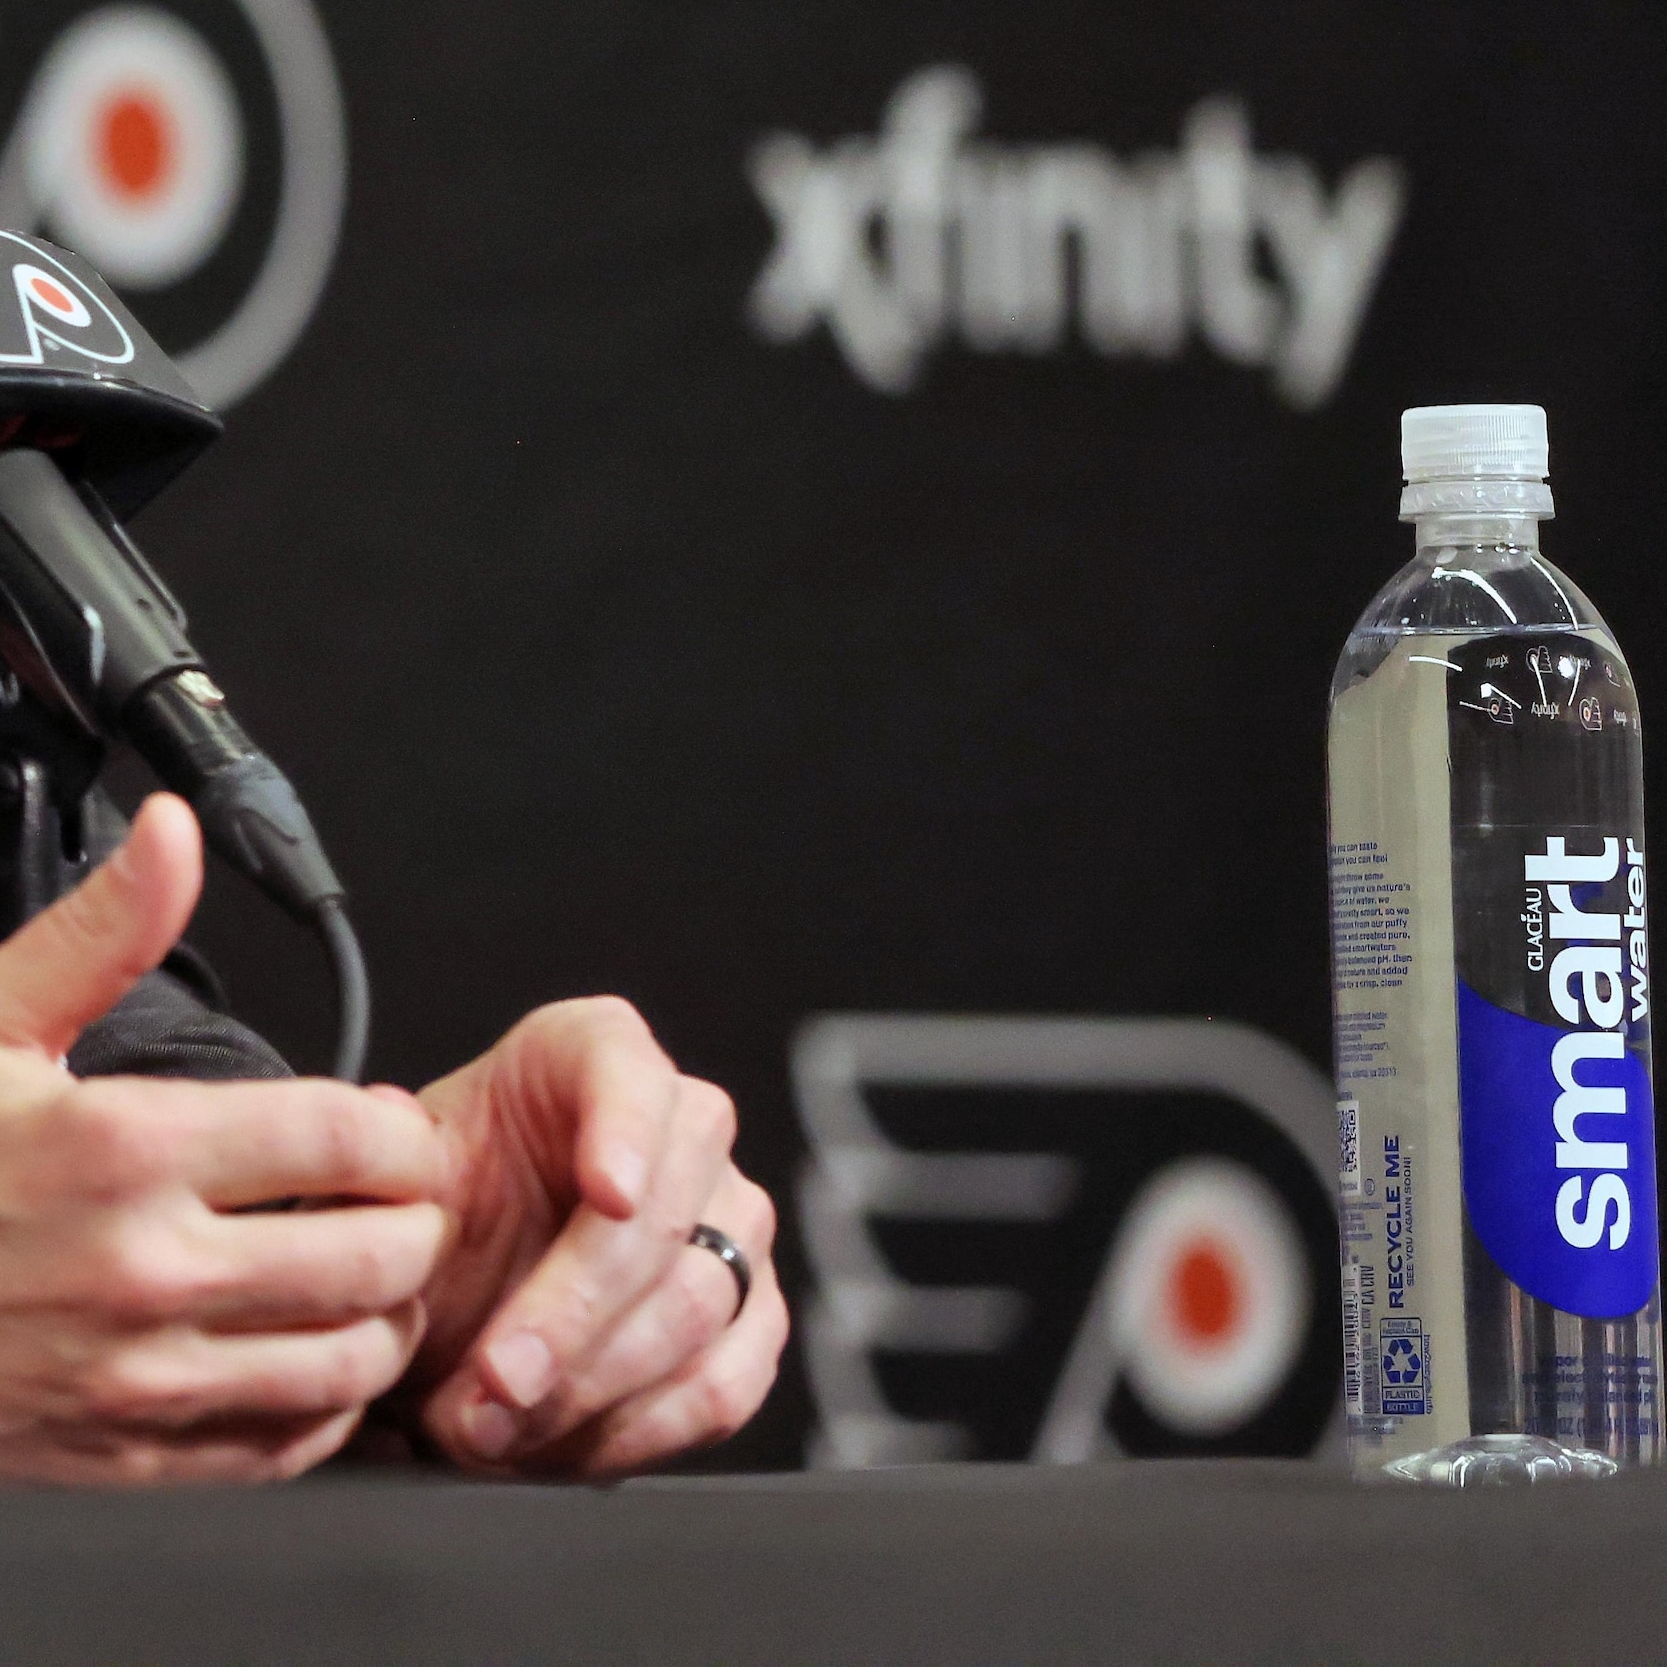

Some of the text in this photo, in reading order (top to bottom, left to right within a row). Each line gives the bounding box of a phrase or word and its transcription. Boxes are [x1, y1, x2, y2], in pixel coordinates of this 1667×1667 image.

[746, 63, 1408, 410] xfinity
[1520, 887, 1544, 972] GLACÉAU
[1623, 837, 1648, 1022] water
[1524, 836, 1631, 1251] smart
[1384, 1135, 1404, 1309] RECYCLE ME
[1404, 1197, 1413, 1234] AGAIN
[1406, 1240, 1414, 1262] YOU
[1406, 1264, 1415, 1287] SEE
[1385, 1390, 1420, 1399] PLASTIC
